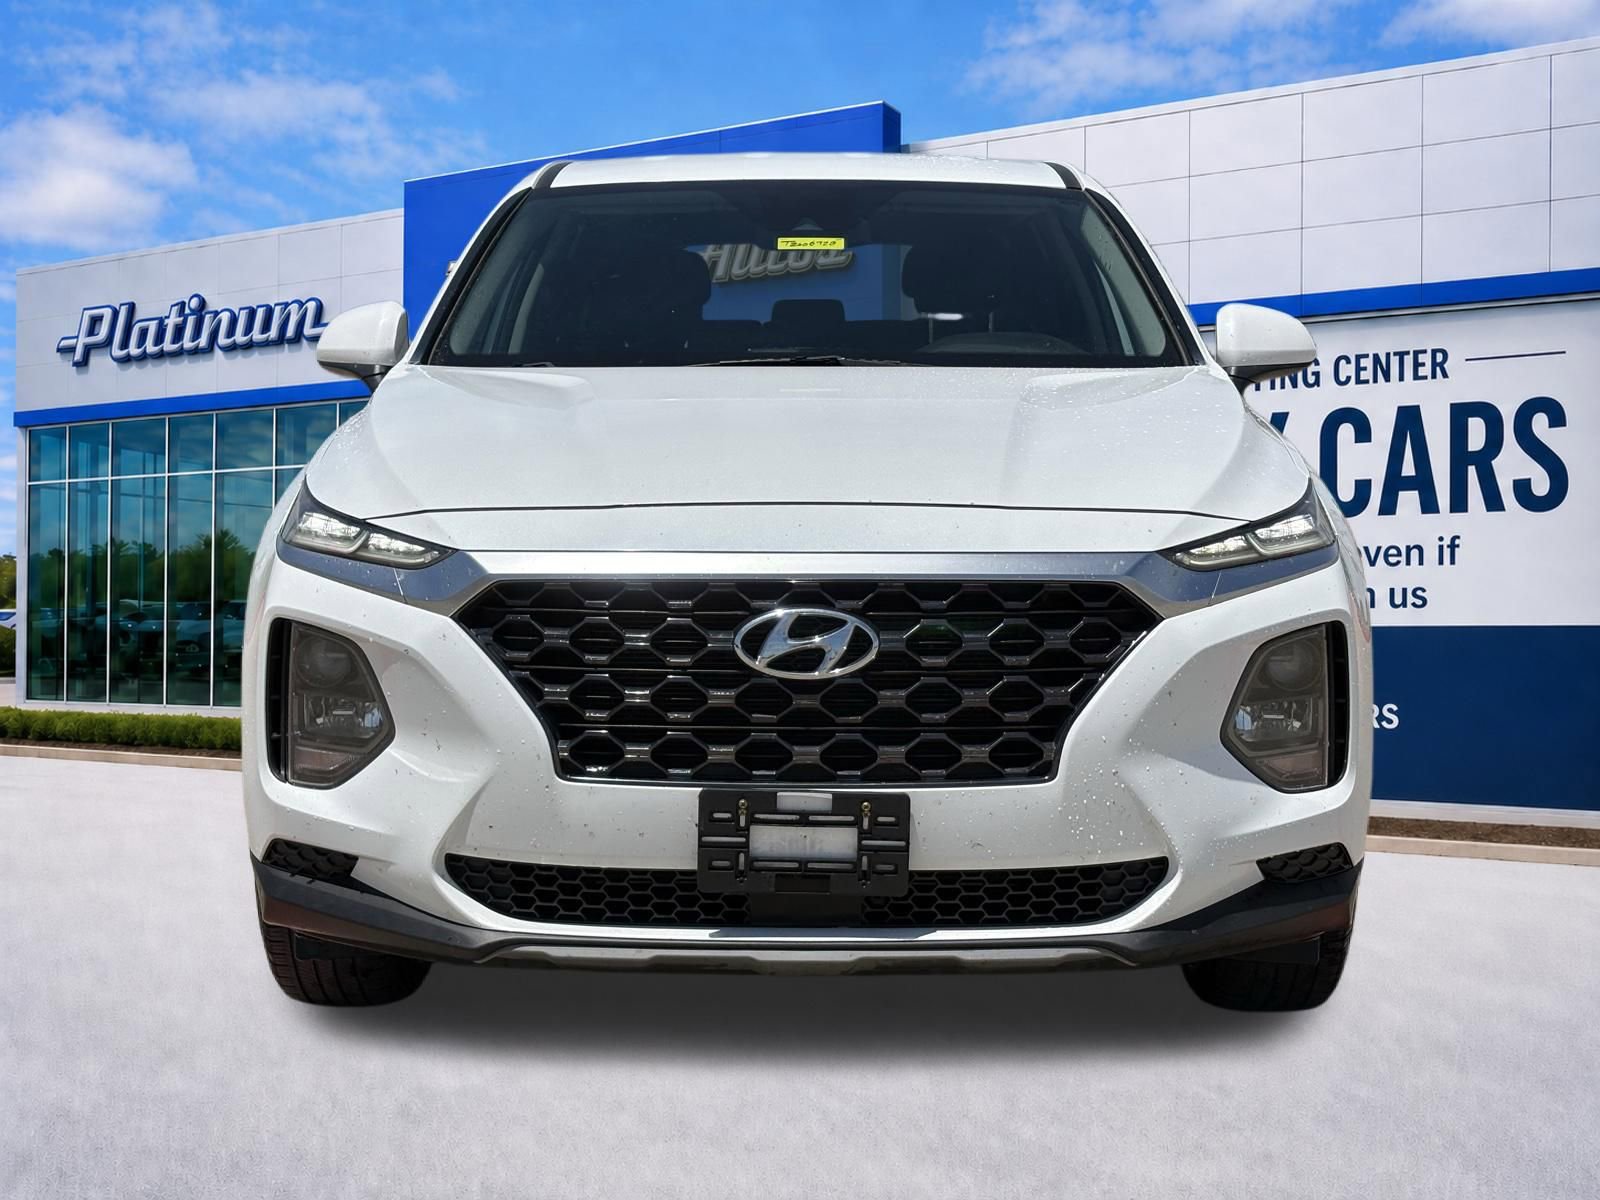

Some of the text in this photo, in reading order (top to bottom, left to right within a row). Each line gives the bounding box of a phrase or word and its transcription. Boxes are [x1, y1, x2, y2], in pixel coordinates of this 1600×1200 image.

[56, 293, 329, 367] Platinum
[1254, 348, 1450, 392] NG CENTER
[1319, 396, 1569, 518] CARS
[1357, 534, 1461, 568] ven if
[1388, 586, 1428, 609] us
